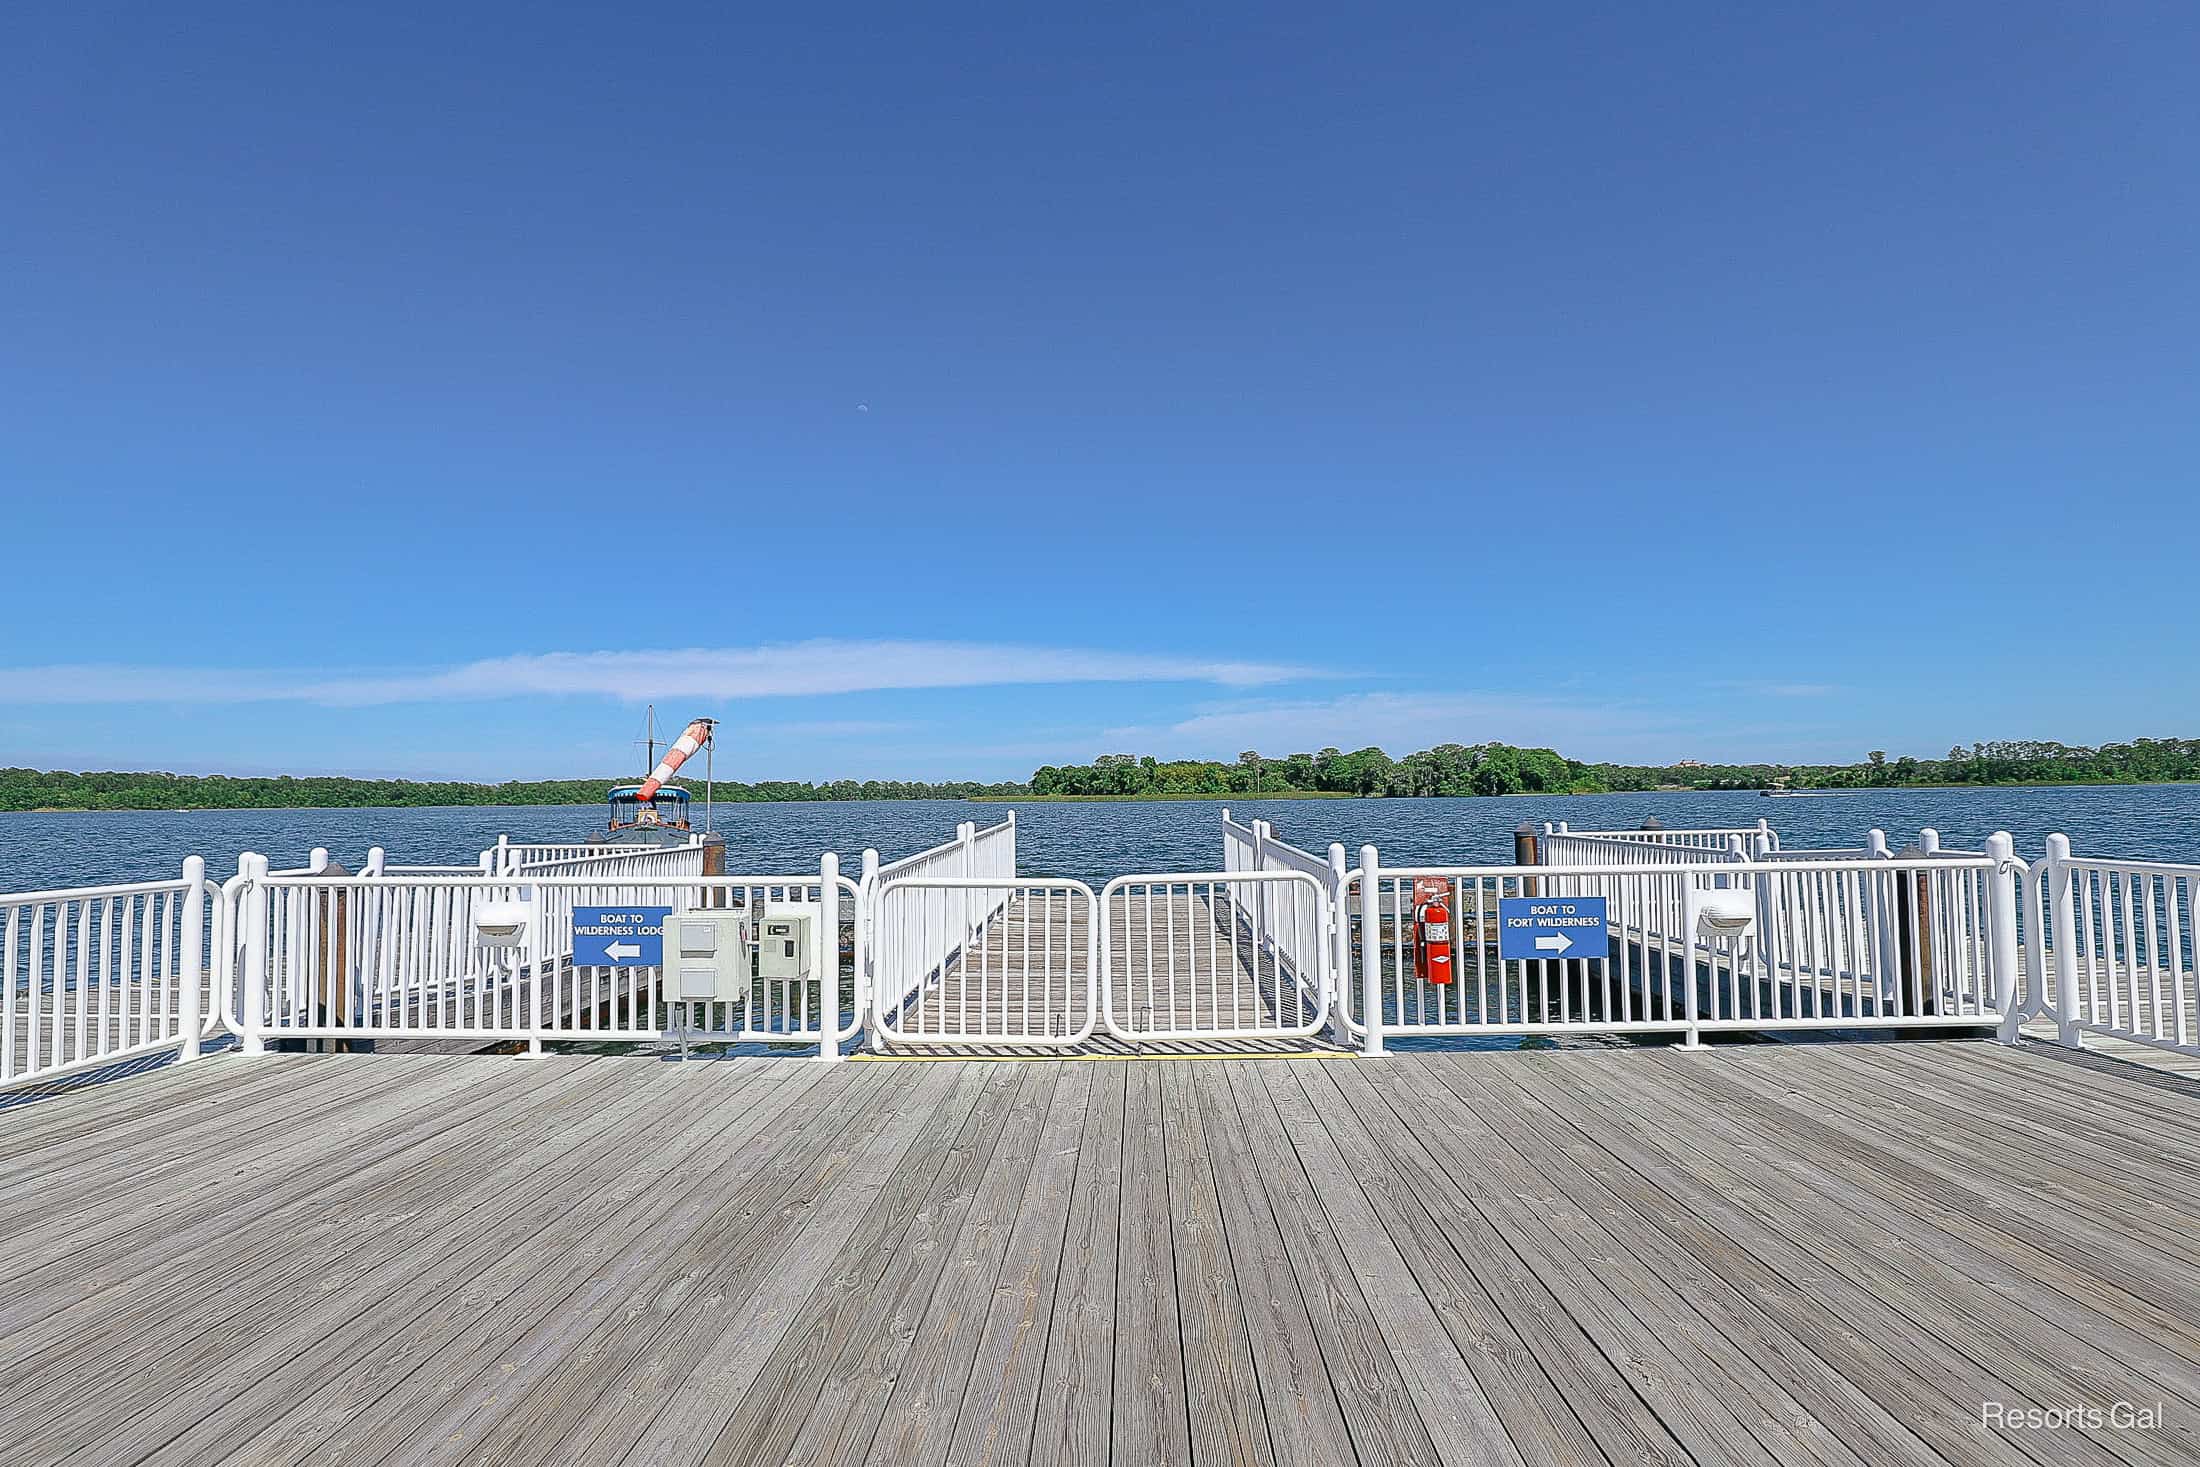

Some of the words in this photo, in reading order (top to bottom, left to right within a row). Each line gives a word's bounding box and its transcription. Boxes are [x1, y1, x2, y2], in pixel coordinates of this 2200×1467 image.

[1530, 905, 1559, 915] BOAT
[1561, 905, 1576, 915] TO
[600, 914, 627, 924] BOAT
[630, 914, 644, 924] TO
[1507, 918, 1534, 928] FORT
[1536, 917, 1600, 927] WILDERNESS
[574, 926, 634, 936] WILDERNESS
[637, 926, 665, 936] LODG
